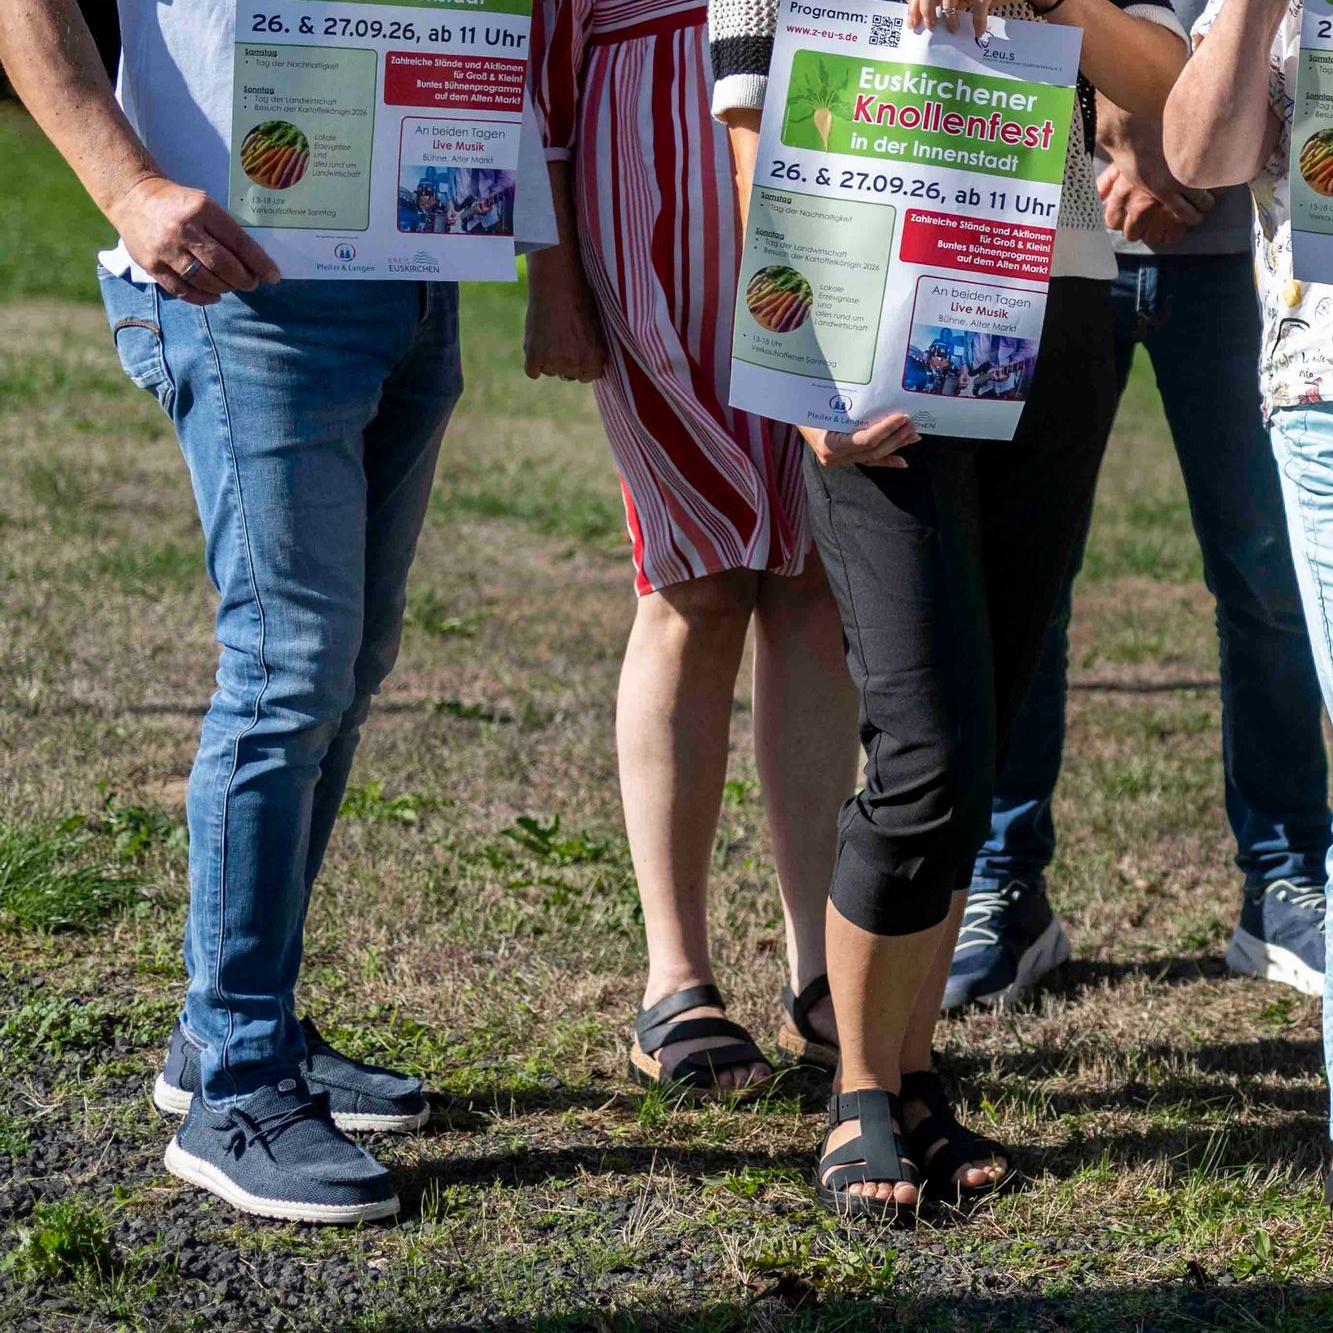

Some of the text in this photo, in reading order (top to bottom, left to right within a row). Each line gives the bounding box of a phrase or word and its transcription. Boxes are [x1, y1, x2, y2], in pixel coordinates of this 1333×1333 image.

[788, 1, 869, 26] Programm:
[252, 13, 526, 49] 26. & 27.09.26, ab 11 Uhr
[785, 23, 858, 42] www.z-eu-s.de
[983, 48, 1015, 61] z.eu.s
[859, 66, 1038, 113] Euskirchener
[852, 91, 1055, 151] Knollenfest
[432, 139, 484, 151] Live Musik
[850, 132, 1019, 172] in der Innenstadt
[770, 159, 1056, 218] 26. & 27.09.26, ab 11 Uhr
[950, 301, 1008, 319] Live Musik
